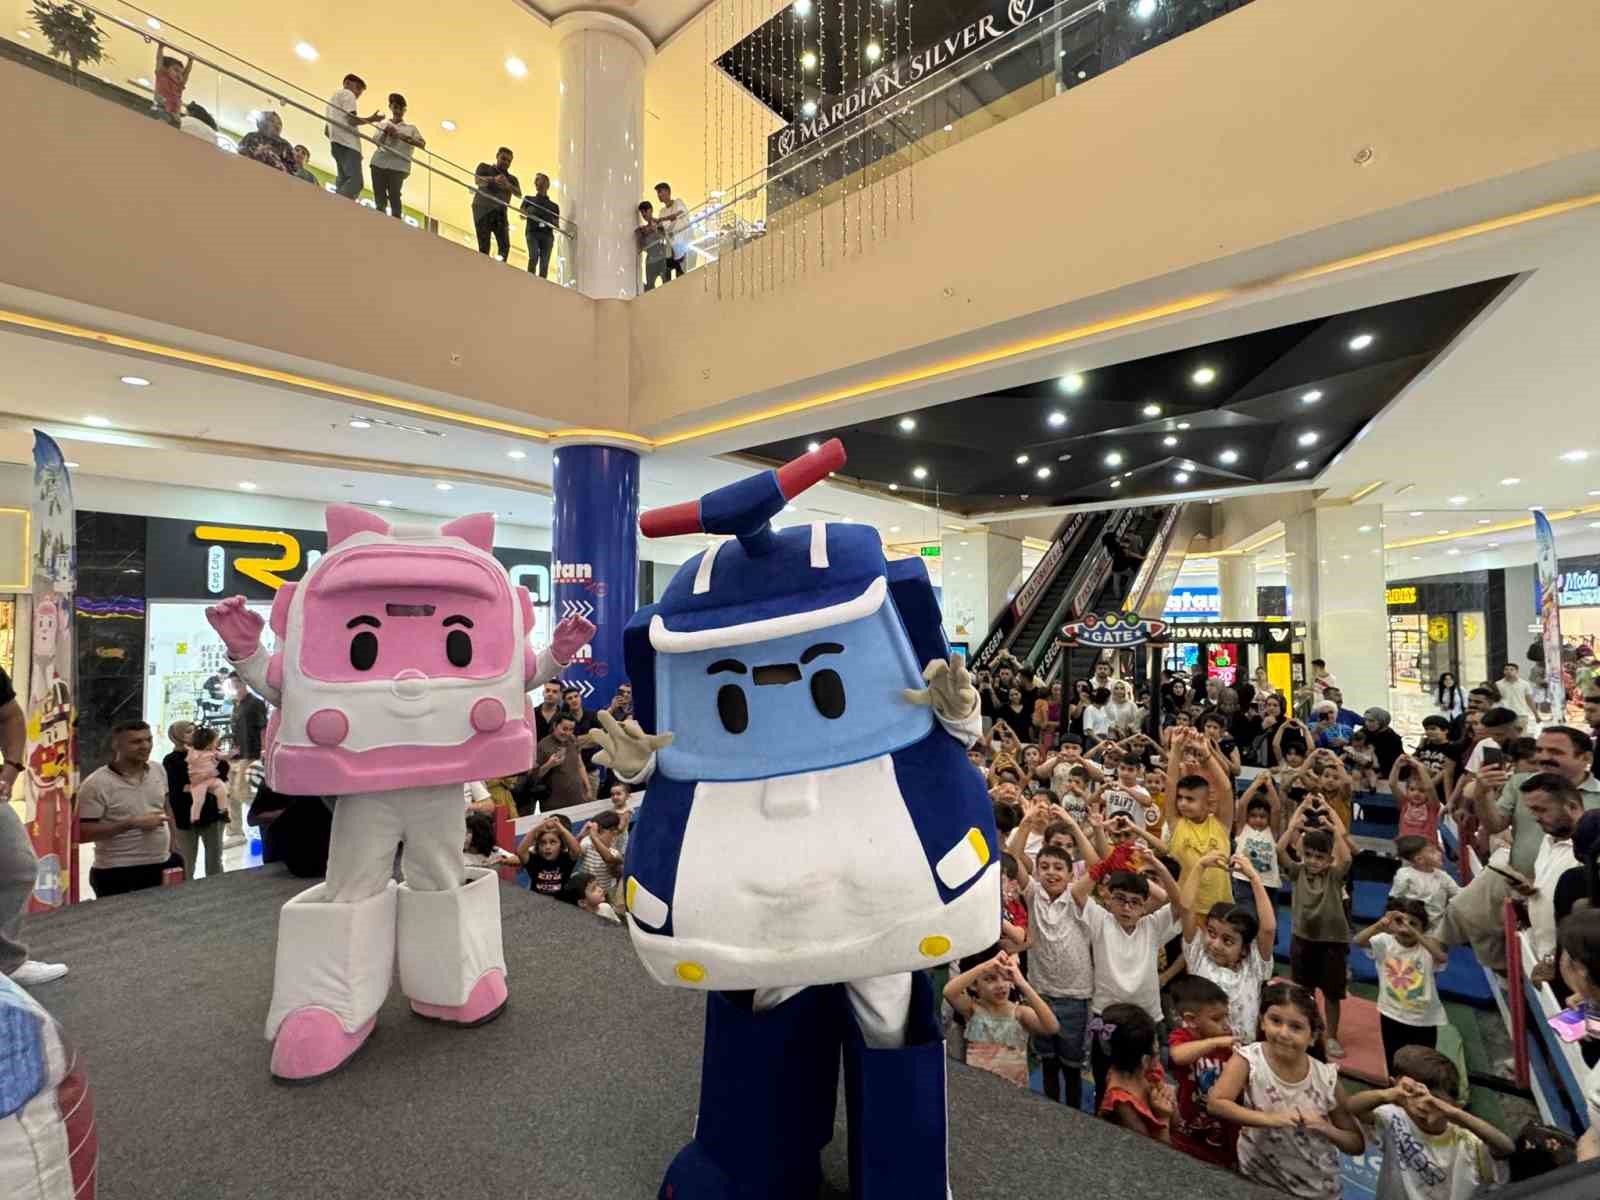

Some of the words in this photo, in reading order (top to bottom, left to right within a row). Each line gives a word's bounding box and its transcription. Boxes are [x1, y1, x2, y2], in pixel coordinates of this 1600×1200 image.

[800, 71, 906, 142] MARDIAN
[909, 14, 1004, 81] SILVER
[1091, 630, 1134, 642] GATE
